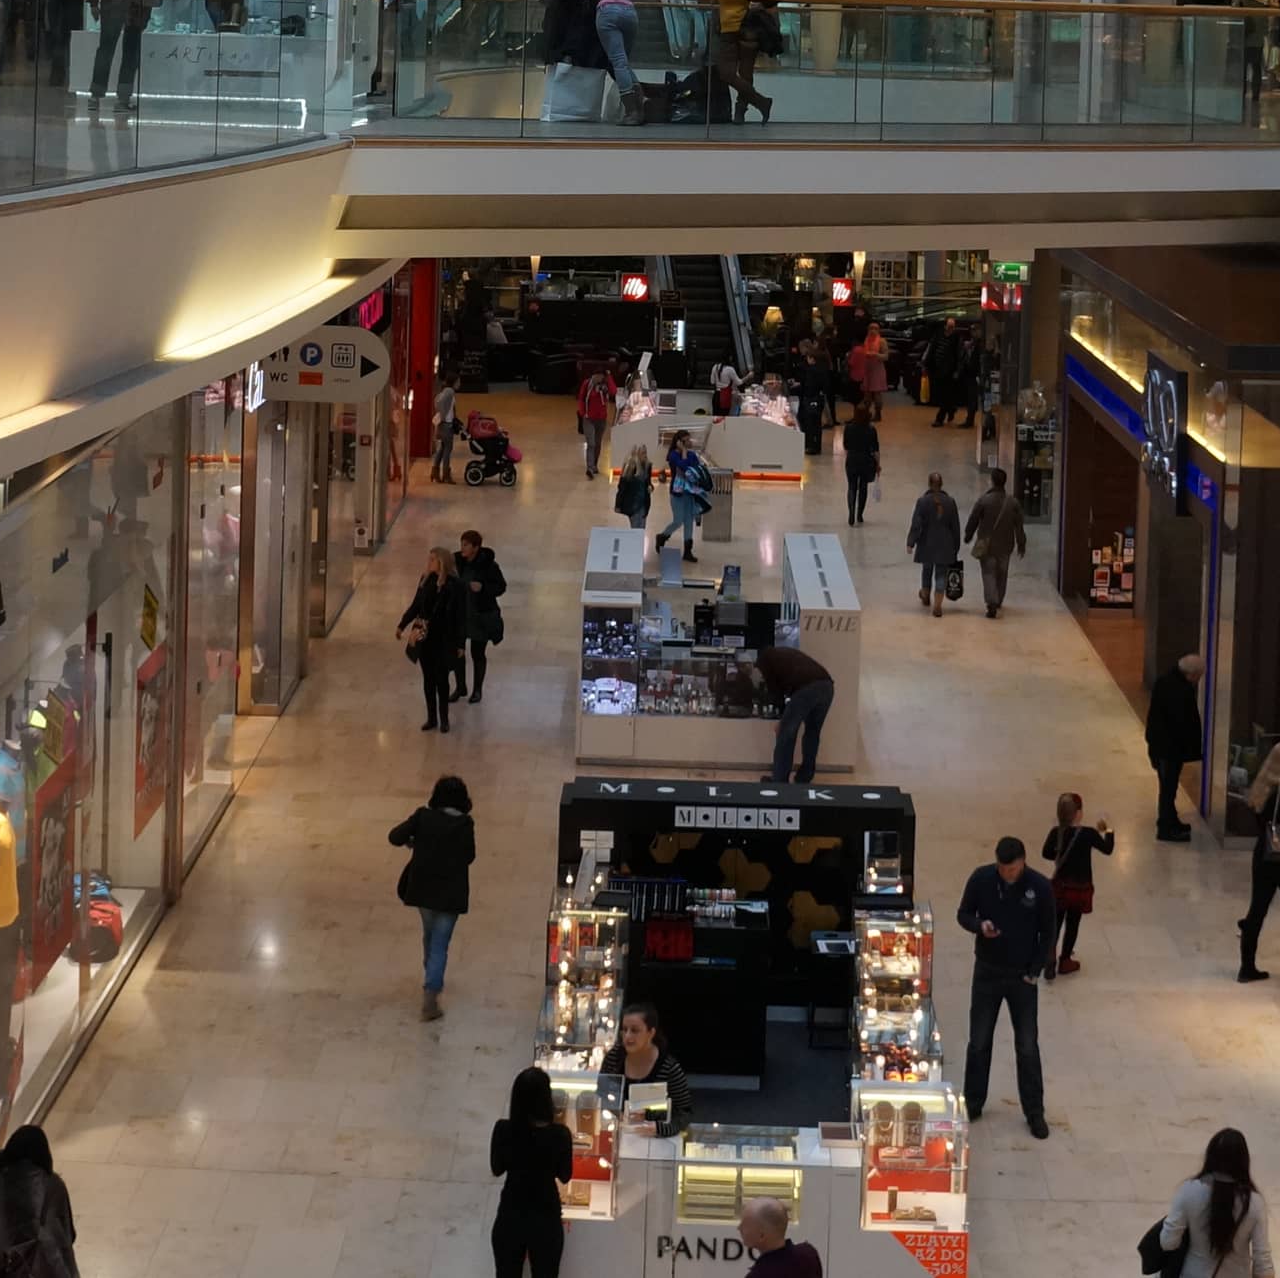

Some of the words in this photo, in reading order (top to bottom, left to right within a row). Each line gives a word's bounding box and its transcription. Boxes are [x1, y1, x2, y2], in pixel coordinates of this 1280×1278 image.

[623, 277, 648, 300] illy
[270, 372, 289, 383] WC
[804, 615, 859, 633] TIME
[941, 1249, 965, 1261] DO
